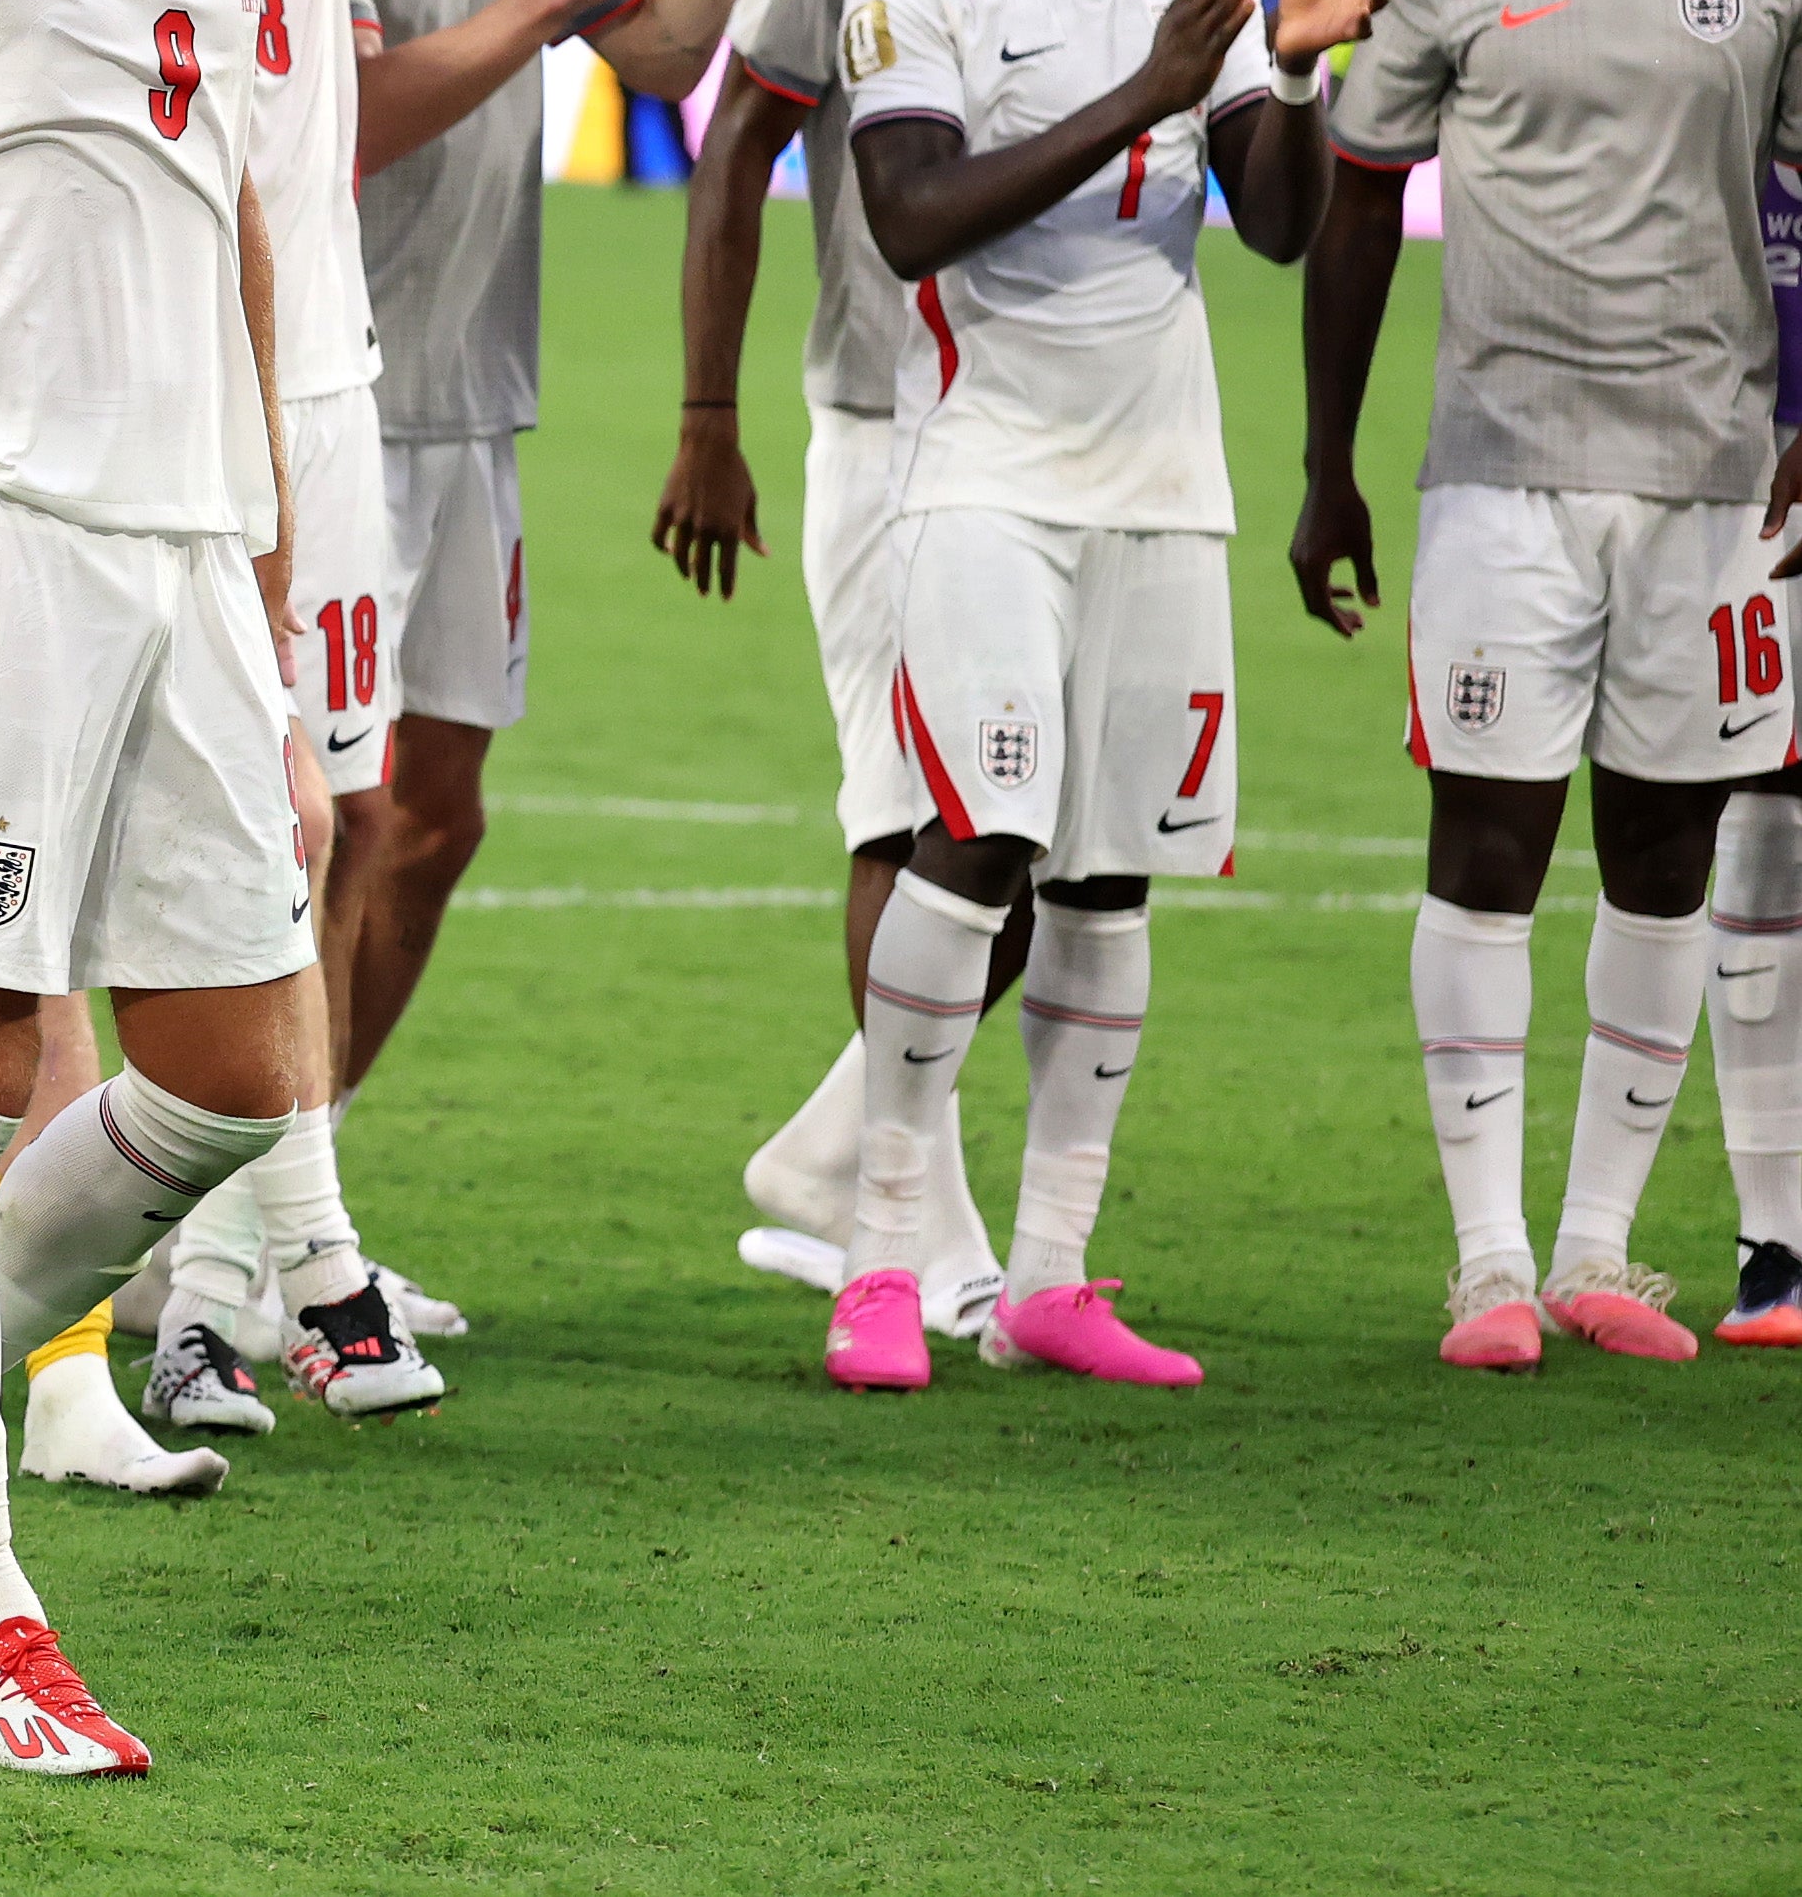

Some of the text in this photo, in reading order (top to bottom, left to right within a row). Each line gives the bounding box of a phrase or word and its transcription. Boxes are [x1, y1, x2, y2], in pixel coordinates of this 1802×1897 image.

[147, 8, 203, 143] 9
[315, 592, 379, 713] 18
[1707, 592, 1785, 706] 16
[1176, 691, 1226, 799] 7
